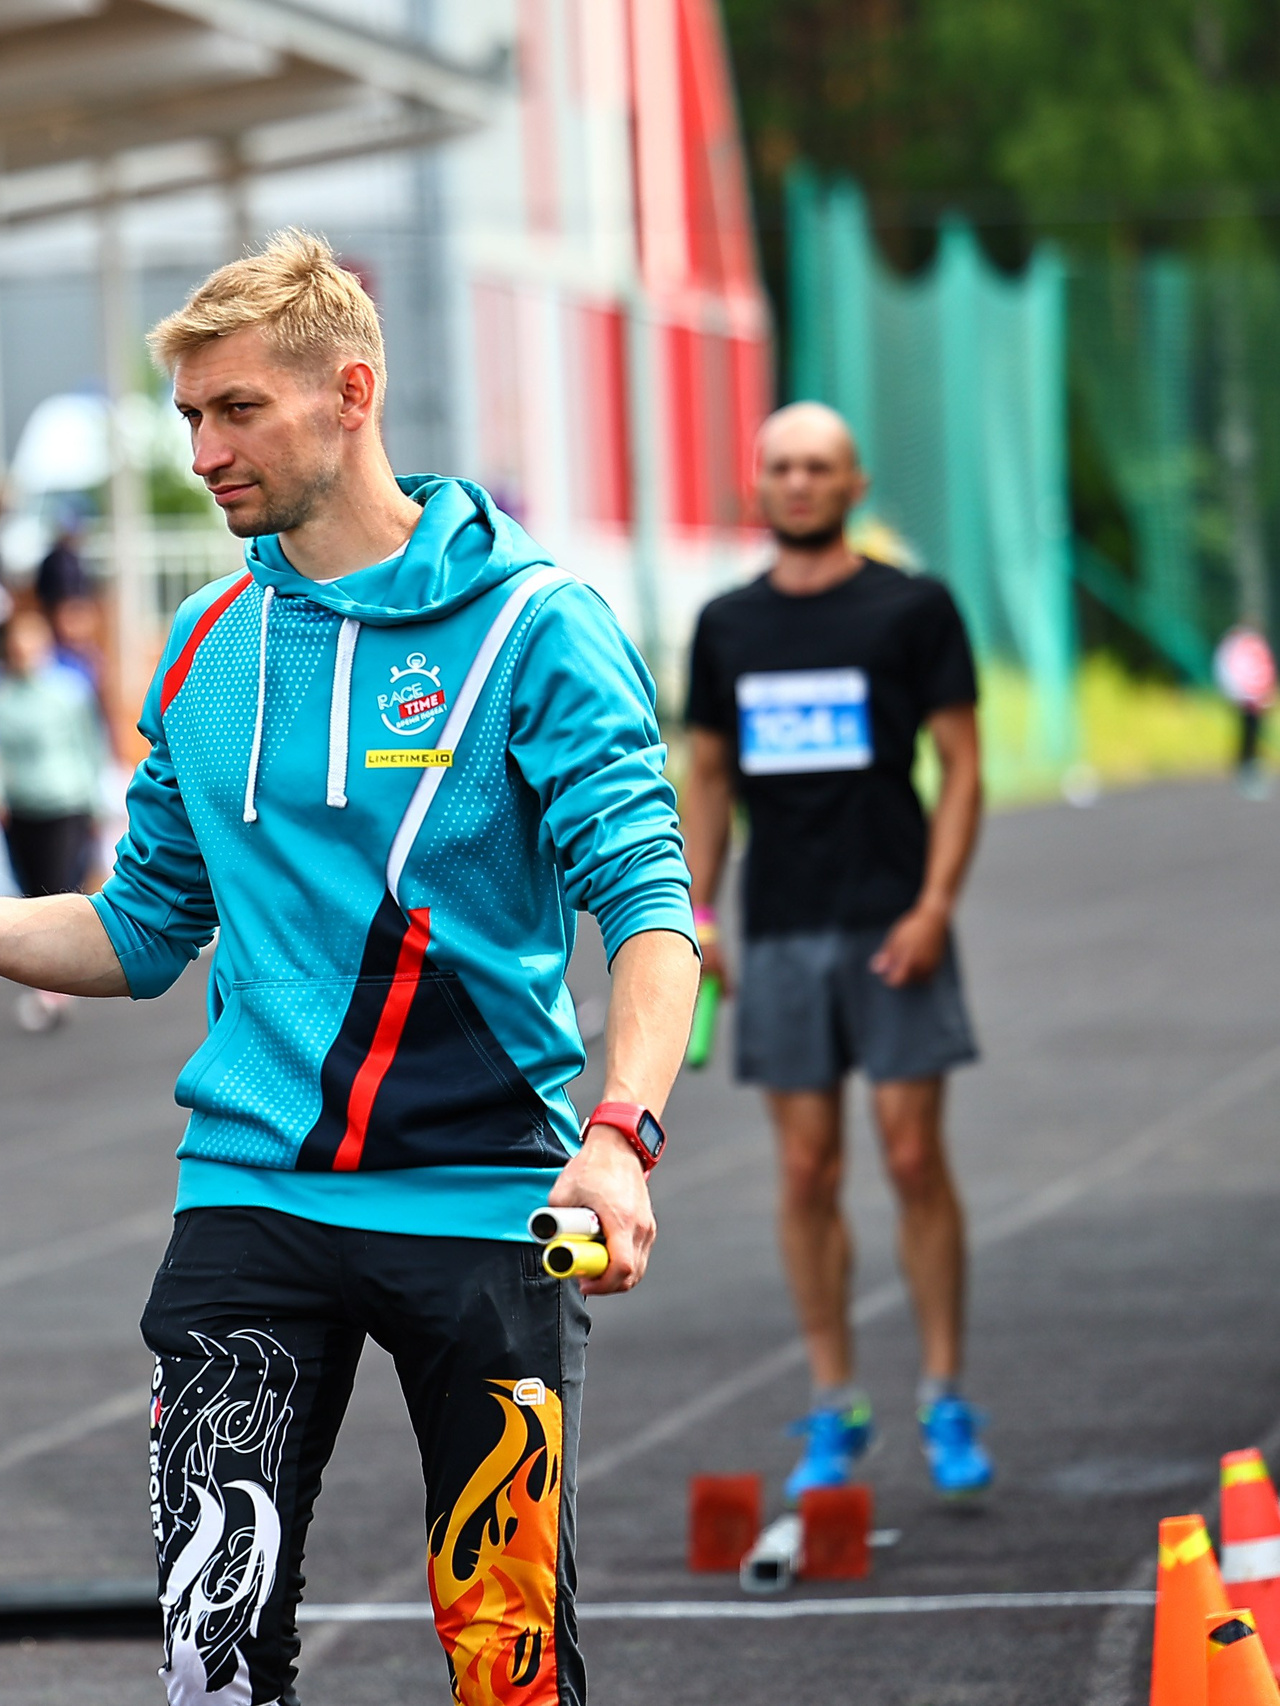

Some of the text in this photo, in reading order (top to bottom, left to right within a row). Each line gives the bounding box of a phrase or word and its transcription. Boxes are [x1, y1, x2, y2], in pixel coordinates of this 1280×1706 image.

[377, 682, 424, 711] RACE
[404, 694, 439, 716] TIME
[368, 753, 450, 764] LIMETIME.IO
